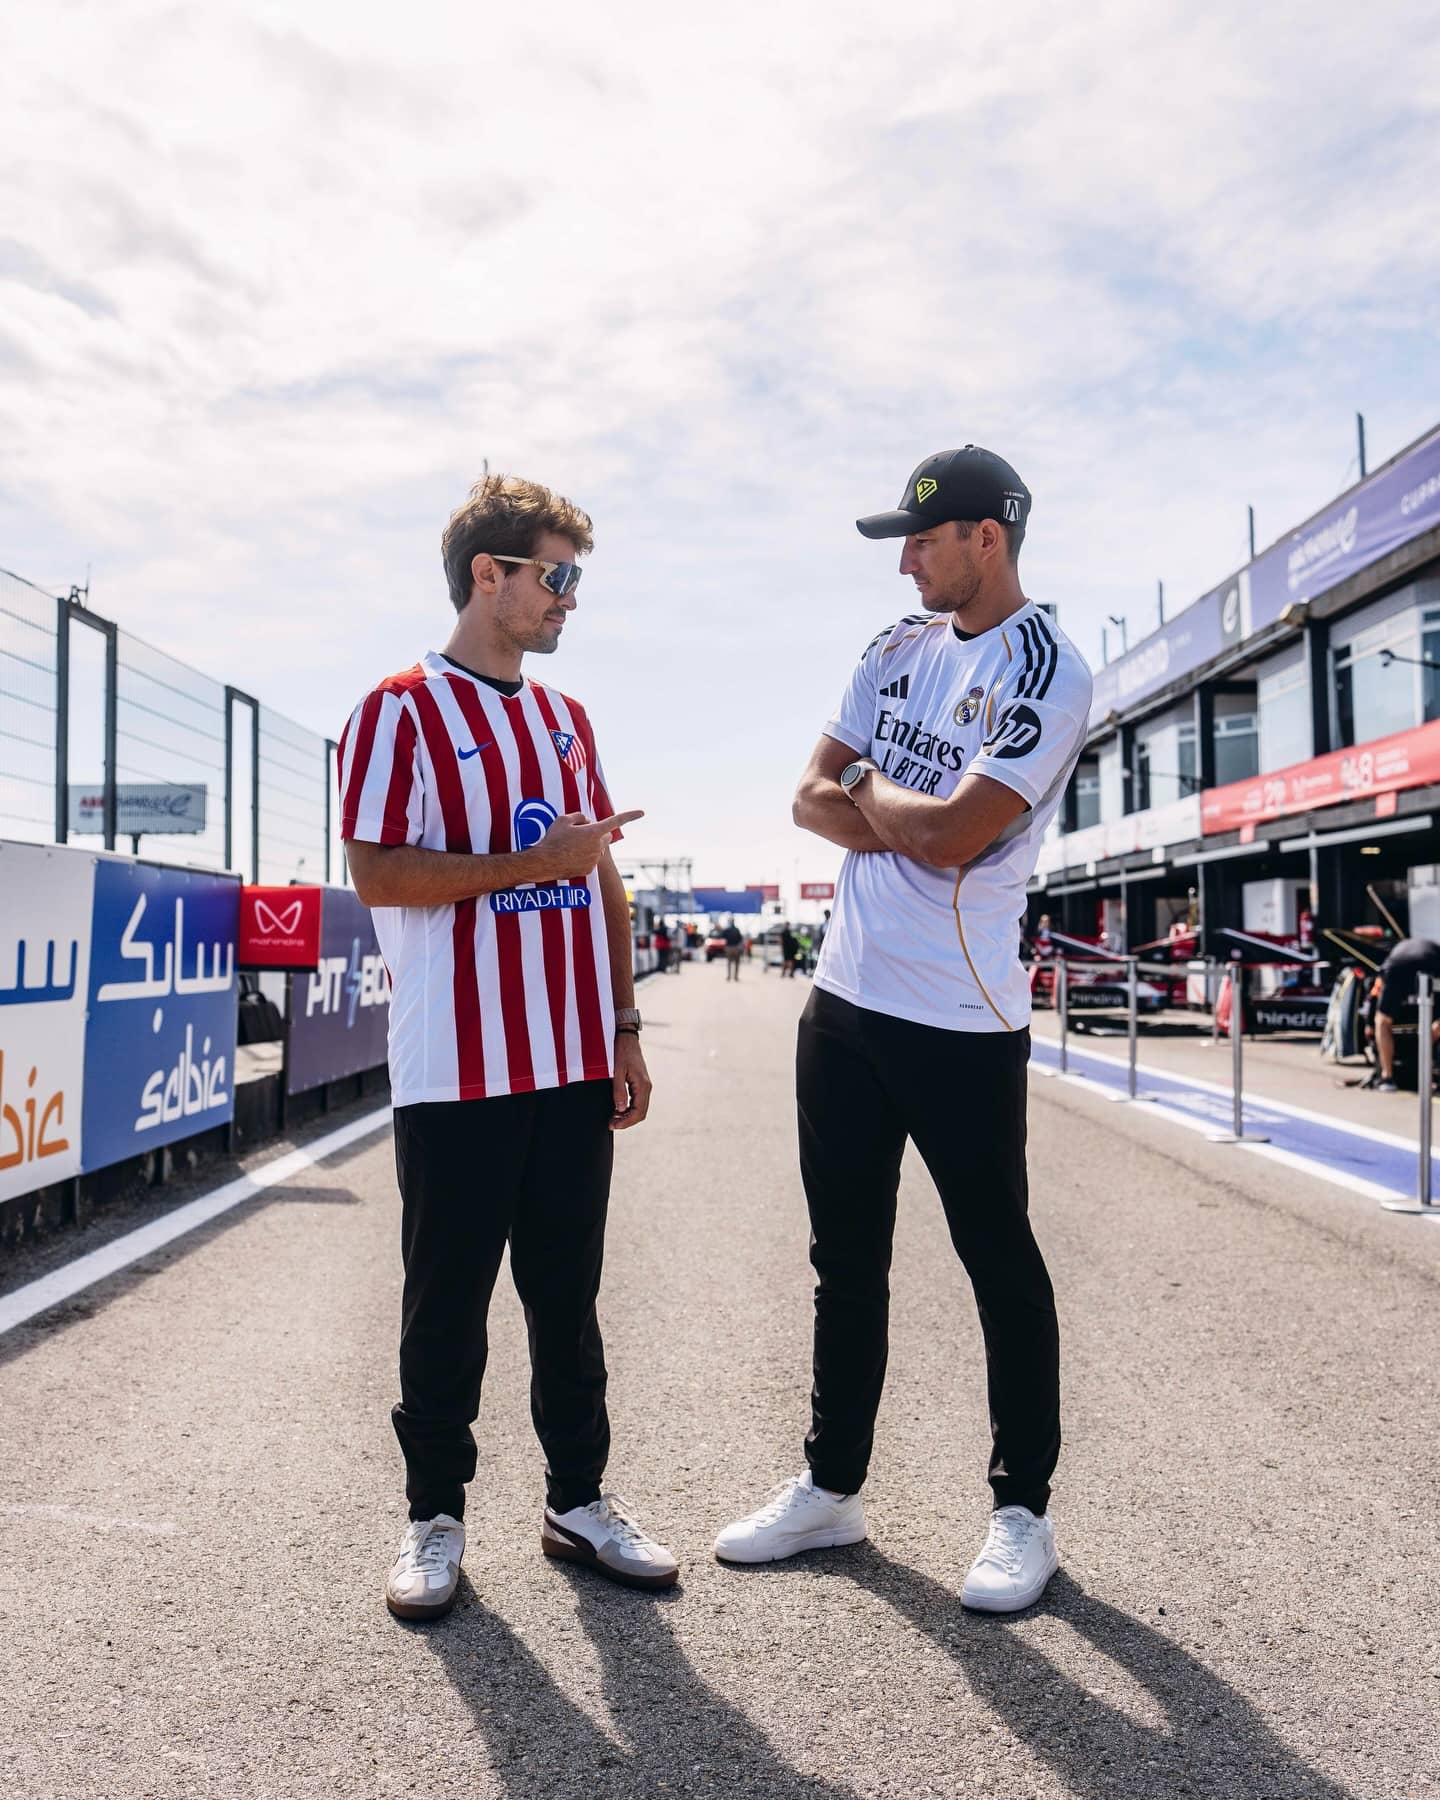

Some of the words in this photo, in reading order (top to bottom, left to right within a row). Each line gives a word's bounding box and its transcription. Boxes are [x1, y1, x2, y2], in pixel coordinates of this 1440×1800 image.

[874, 709, 965, 772] Emiates
[891, 756, 943, 796] BTTER
[495, 889, 563, 912] RIYADH
[568, 888, 587, 906] IR
[305, 957, 348, 1018] PIT
[360, 954, 392, 1007] BO
[134, 1023, 228, 1132] sabic
